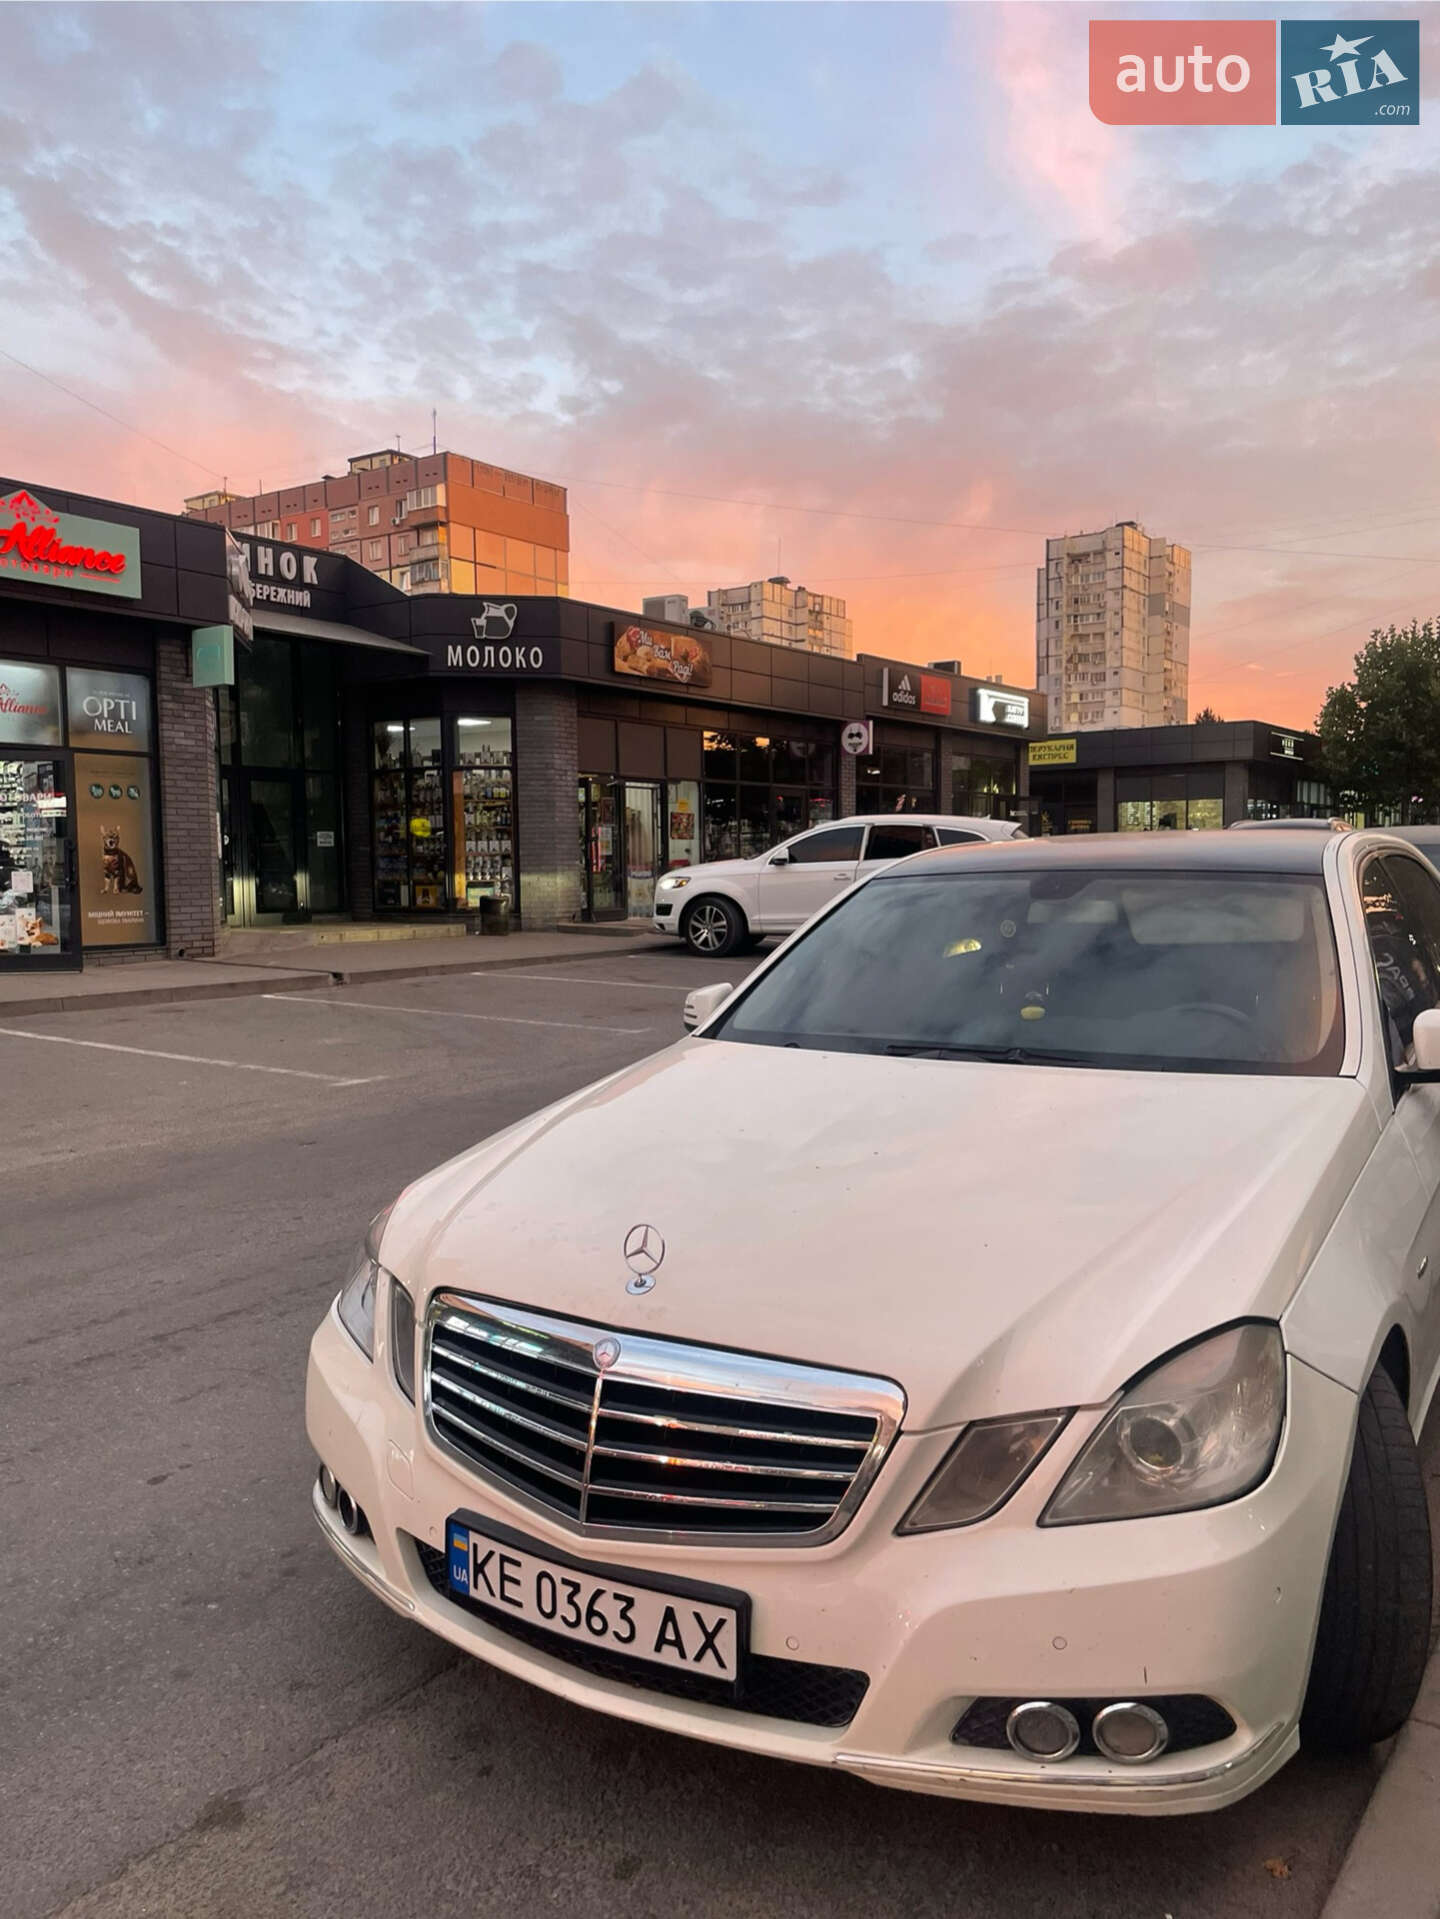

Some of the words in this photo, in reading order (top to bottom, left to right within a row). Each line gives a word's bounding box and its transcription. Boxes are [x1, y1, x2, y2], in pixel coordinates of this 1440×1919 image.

[447, 645, 543, 669] МОЛОКО
[892, 690, 916, 705] adidas
[83, 696, 136, 721] OPTI
[94, 718, 133, 734] MEAL
[453, 1565, 468, 1584] UA
[472, 1543, 523, 1608] KE
[536, 1570, 636, 1644] 0363
[654, 1606, 727, 1669] AX
